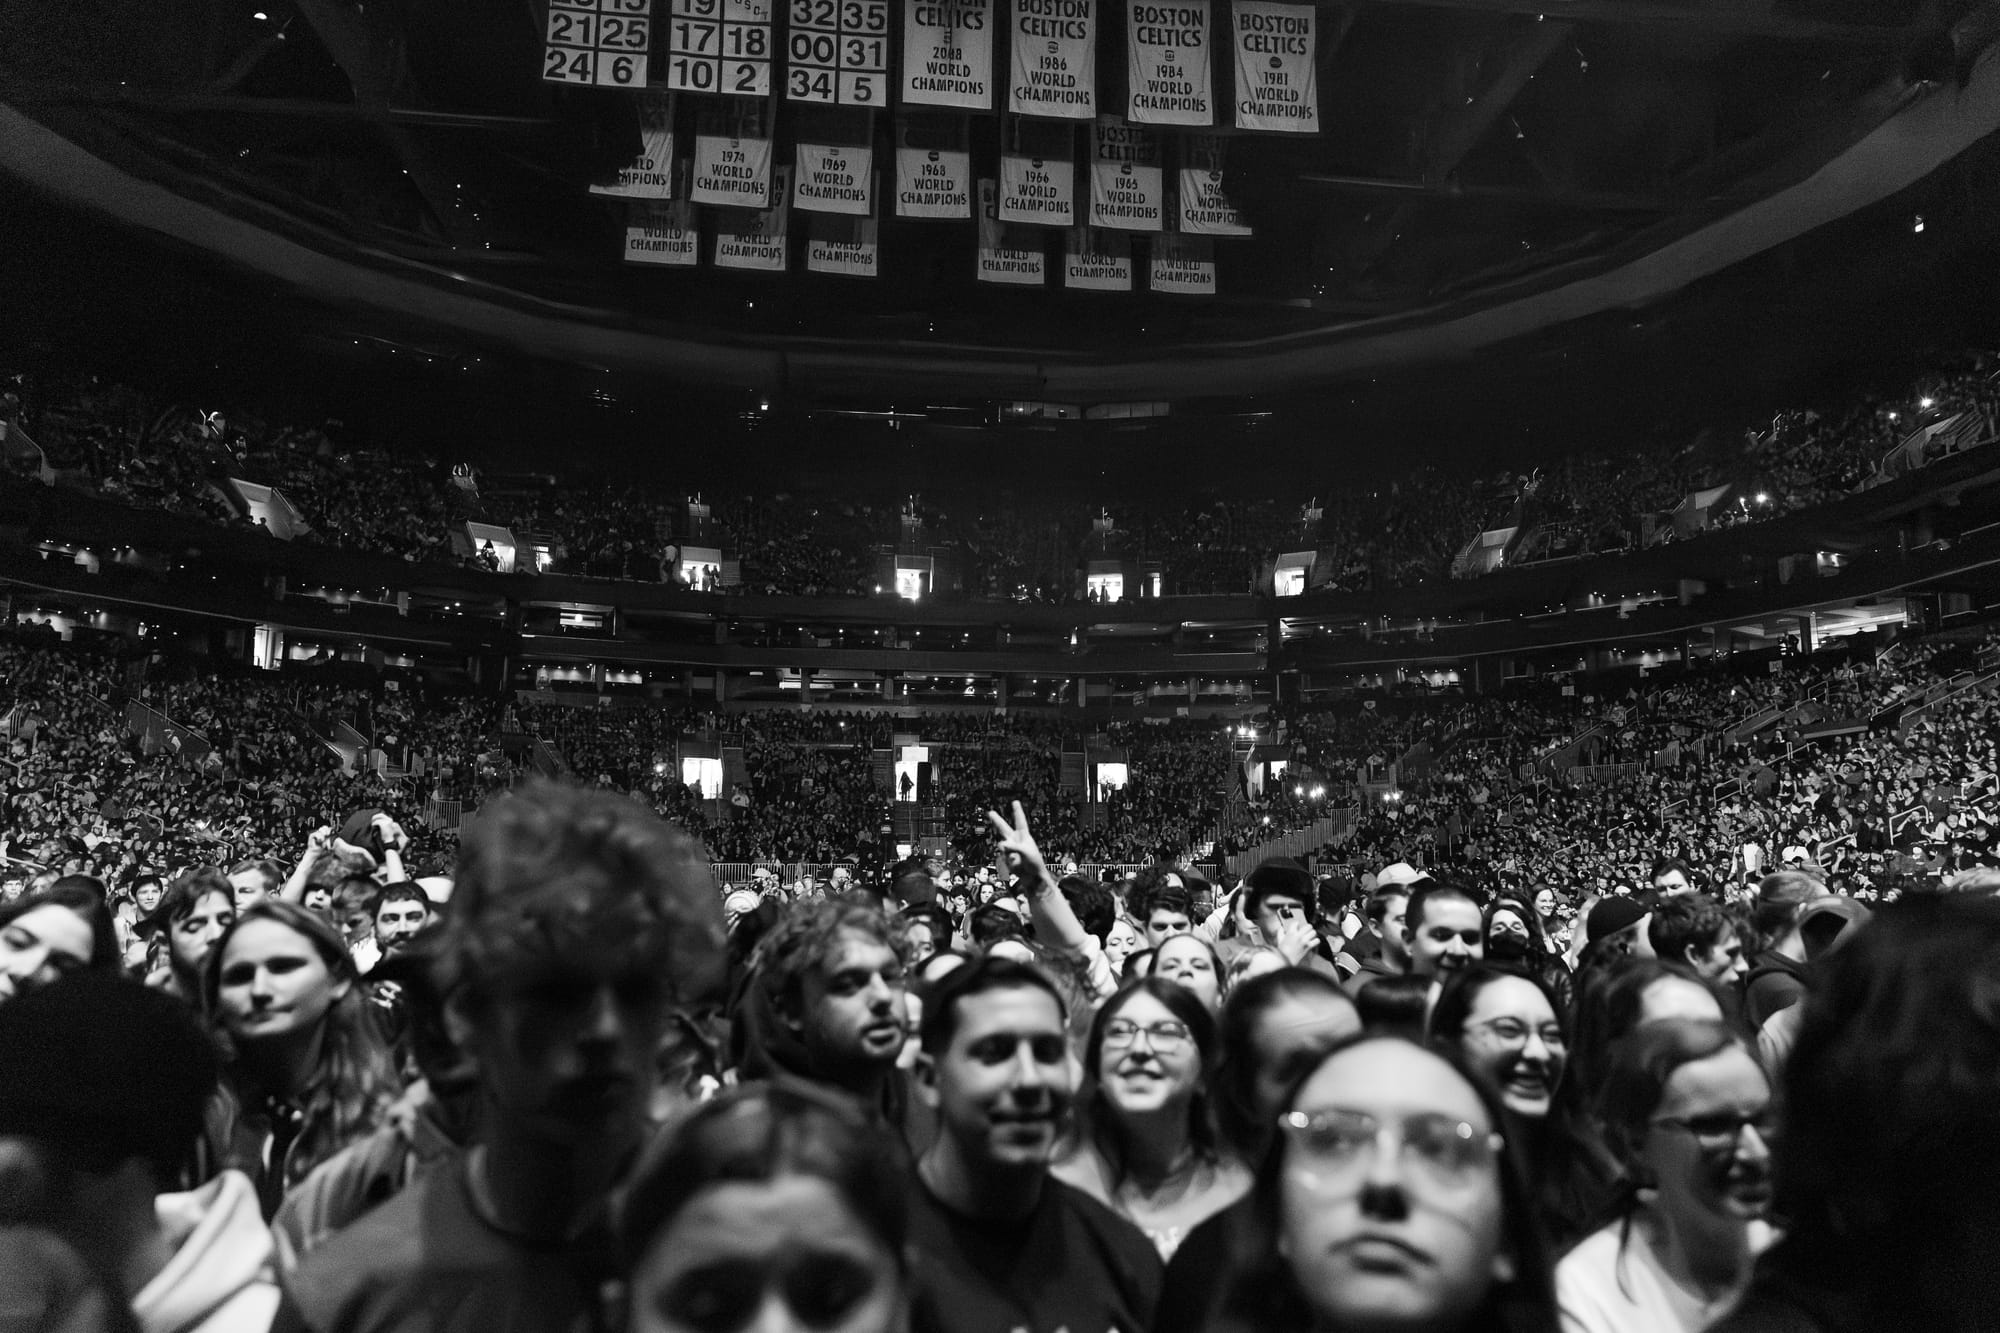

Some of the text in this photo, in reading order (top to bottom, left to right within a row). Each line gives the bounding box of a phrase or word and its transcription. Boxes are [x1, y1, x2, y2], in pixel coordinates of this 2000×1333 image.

[794, 0, 885, 30] 32 35
[1018, 0, 1090, 18] BOSTON
[1133, 6, 1203, 27] BOSTON
[552, 13, 646, 47] 21 25
[1020, 16, 1086, 39] CELTICS
[1240, 14, 1309, 34] BOSTON
[676, 23, 765, 55] 17 18
[1137, 27, 1201, 47] CELTICS
[1244, 34, 1306, 55] CELTICS
[791, 34, 881, 66] 00 31
[545, 50, 633, 84] 24 6
[927, 62, 971, 77] WORLD
[1040, 56, 1067, 71] 1986
[1156, 65, 1184, 78] 1984
[674, 59, 756, 92] 10 2
[1030, 71, 1076, 87] WORLD
[1264, 72, 1288, 85] 1981
[791, 70, 872, 101] 34 5
[912, 77, 984, 95] CHAMPIONS
[1148, 80, 1192, 95] WORLD
[1016, 87, 1090, 104] CHAMPIONS
[1255, 87, 1299, 102] WORLD
[1134, 94, 1206, 112] CHAMPIONS
[1241, 101, 1312, 119] CHAMPIONS
[722, 151, 745, 163] 1974
[822, 158, 846, 171] 1969
[712, 164, 753, 179] WORLD
[813, 172, 853, 186] WORLD
[1026, 170, 1049, 183] 1966
[697, 177, 765, 194] CHAMPIONS
[799, 183, 866, 201] CHAMPIONS
[914, 178, 953, 191] WORLD
[1018, 184, 1057, 198] WORLD
[901, 192, 967, 205] CHAMPIONS
[1005, 197, 1070, 213] CHAMPIONS
[1107, 190, 1145, 204] WORLD
[1096, 203, 1158, 219] CHAMPIONS
[631, 239, 693, 253] CHAMPIONS
[721, 244, 782, 259] CHAMPIONS
[813, 248, 873, 264] CHAMPIONS
[982, 260, 1040, 273] CHAMPIONS
[1070, 267, 1127, 279] CHAMPIONS
[1154, 270, 1212, 283] CHAMPIONS
